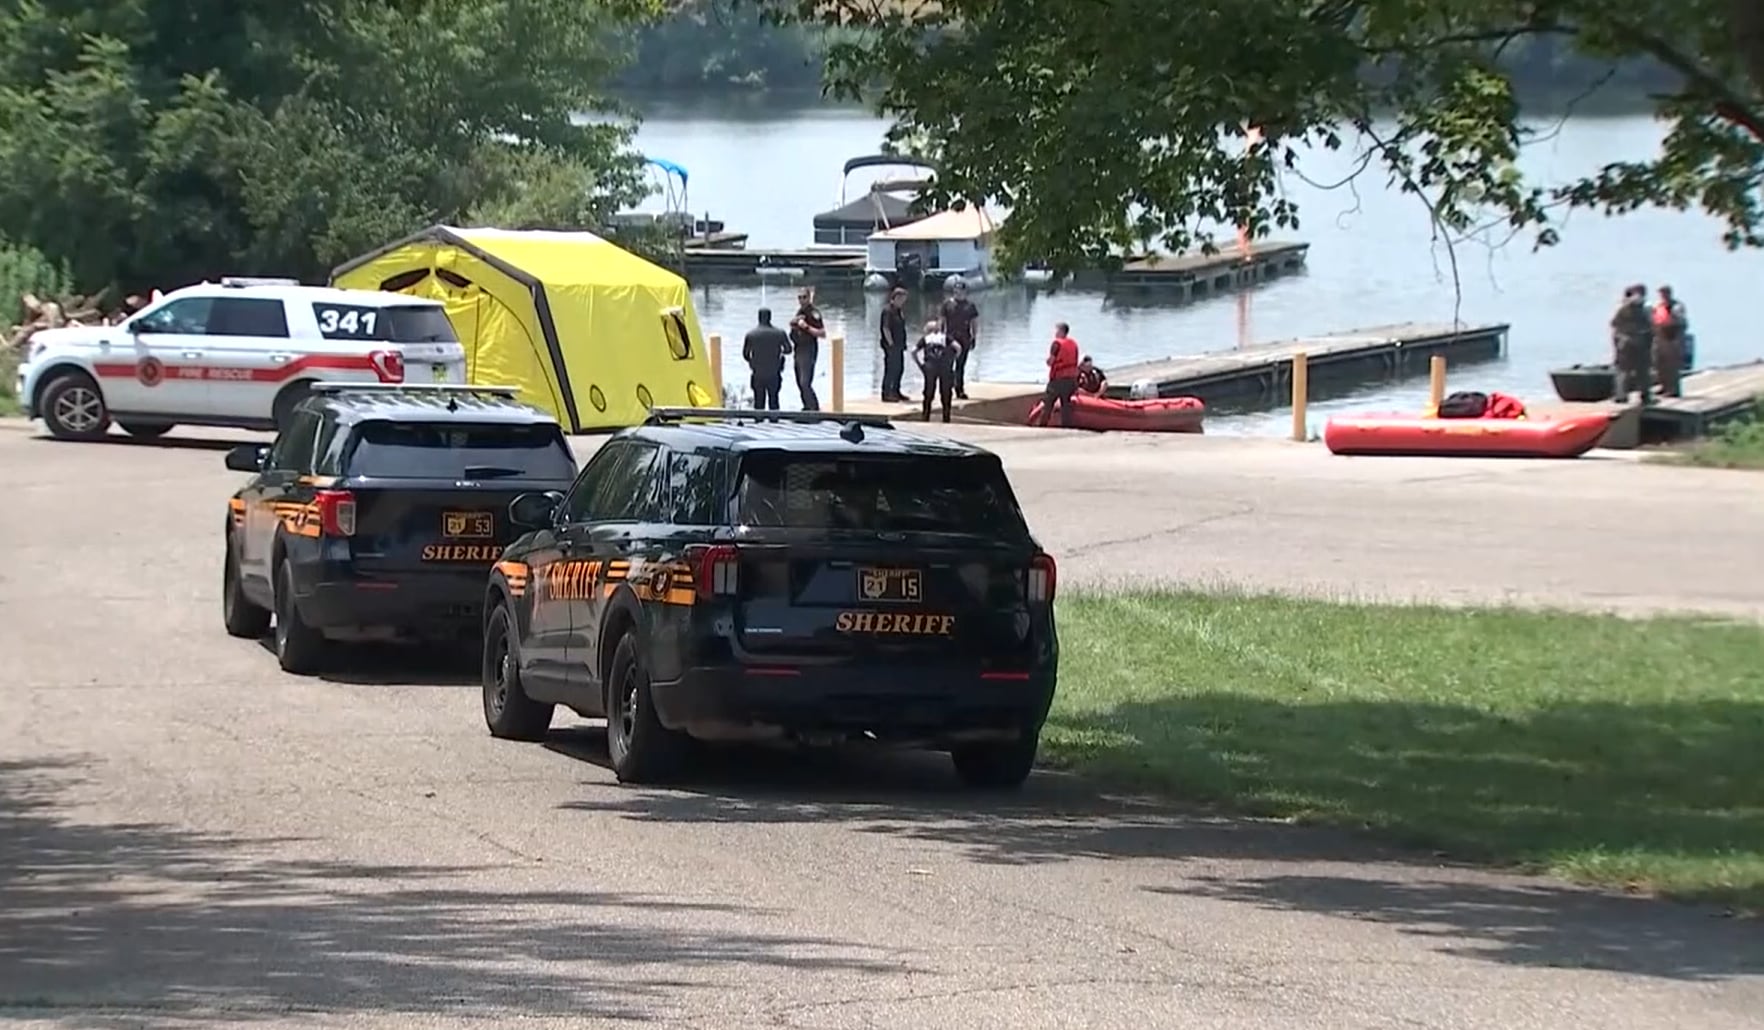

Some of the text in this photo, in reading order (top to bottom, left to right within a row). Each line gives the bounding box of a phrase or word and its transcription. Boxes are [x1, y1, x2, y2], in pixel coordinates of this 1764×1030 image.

[319, 309, 376, 336] 341
[475, 519, 490, 533] 53
[422, 545, 504, 560] SHERIF
[550, 560, 602, 600] SHERIFF
[901, 578, 918, 597] 15
[836, 612, 955, 634] SHERIFF
